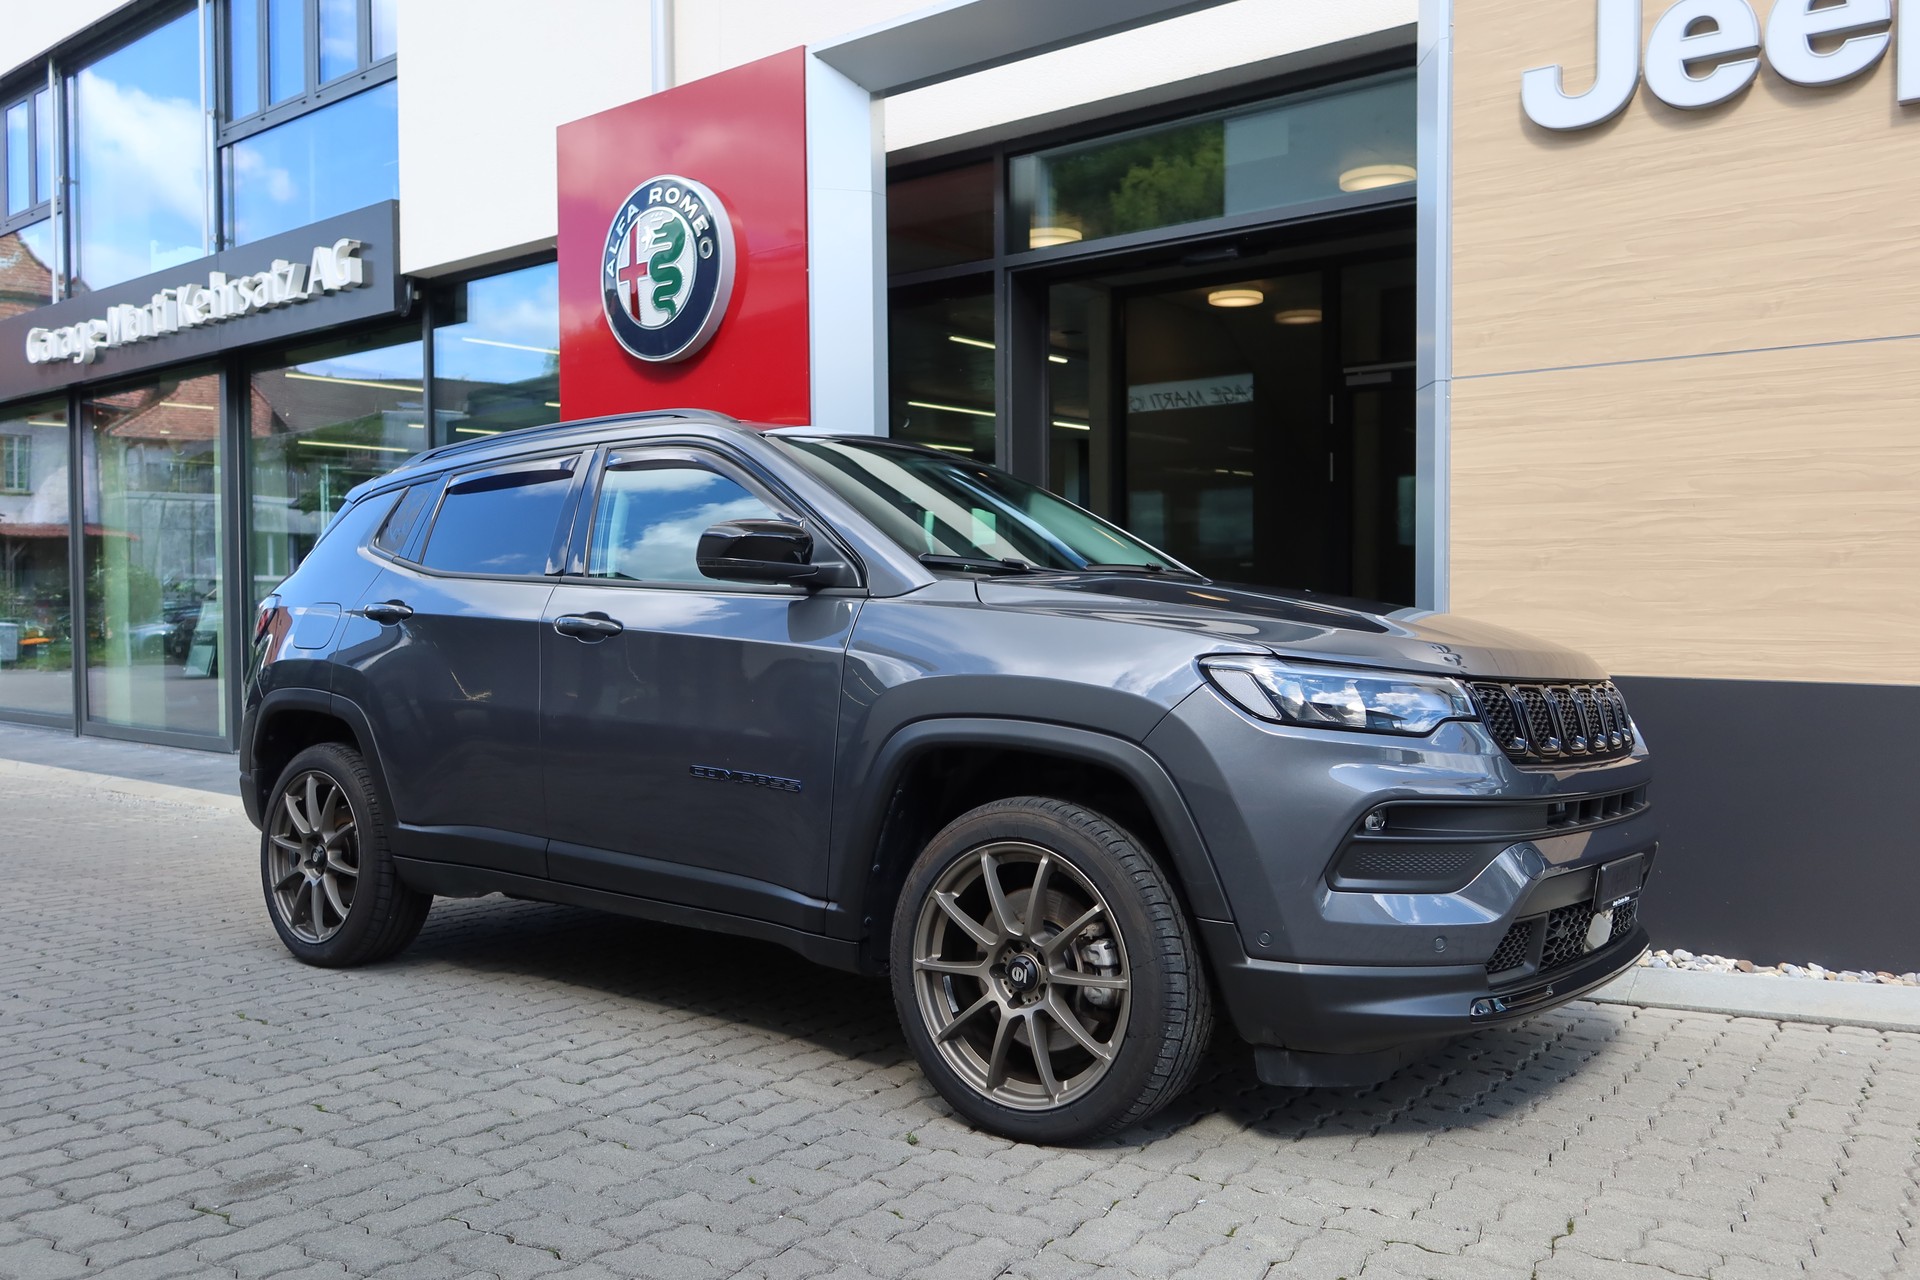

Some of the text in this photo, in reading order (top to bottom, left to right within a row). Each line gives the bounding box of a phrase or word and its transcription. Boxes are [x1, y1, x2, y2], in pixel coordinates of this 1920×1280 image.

[1521, 0, 1920, 131] Jee
[606, 187, 714, 278] ALFA ROMEO
[26, 238, 364, 365] Garage Marti Kehrsatz AG
